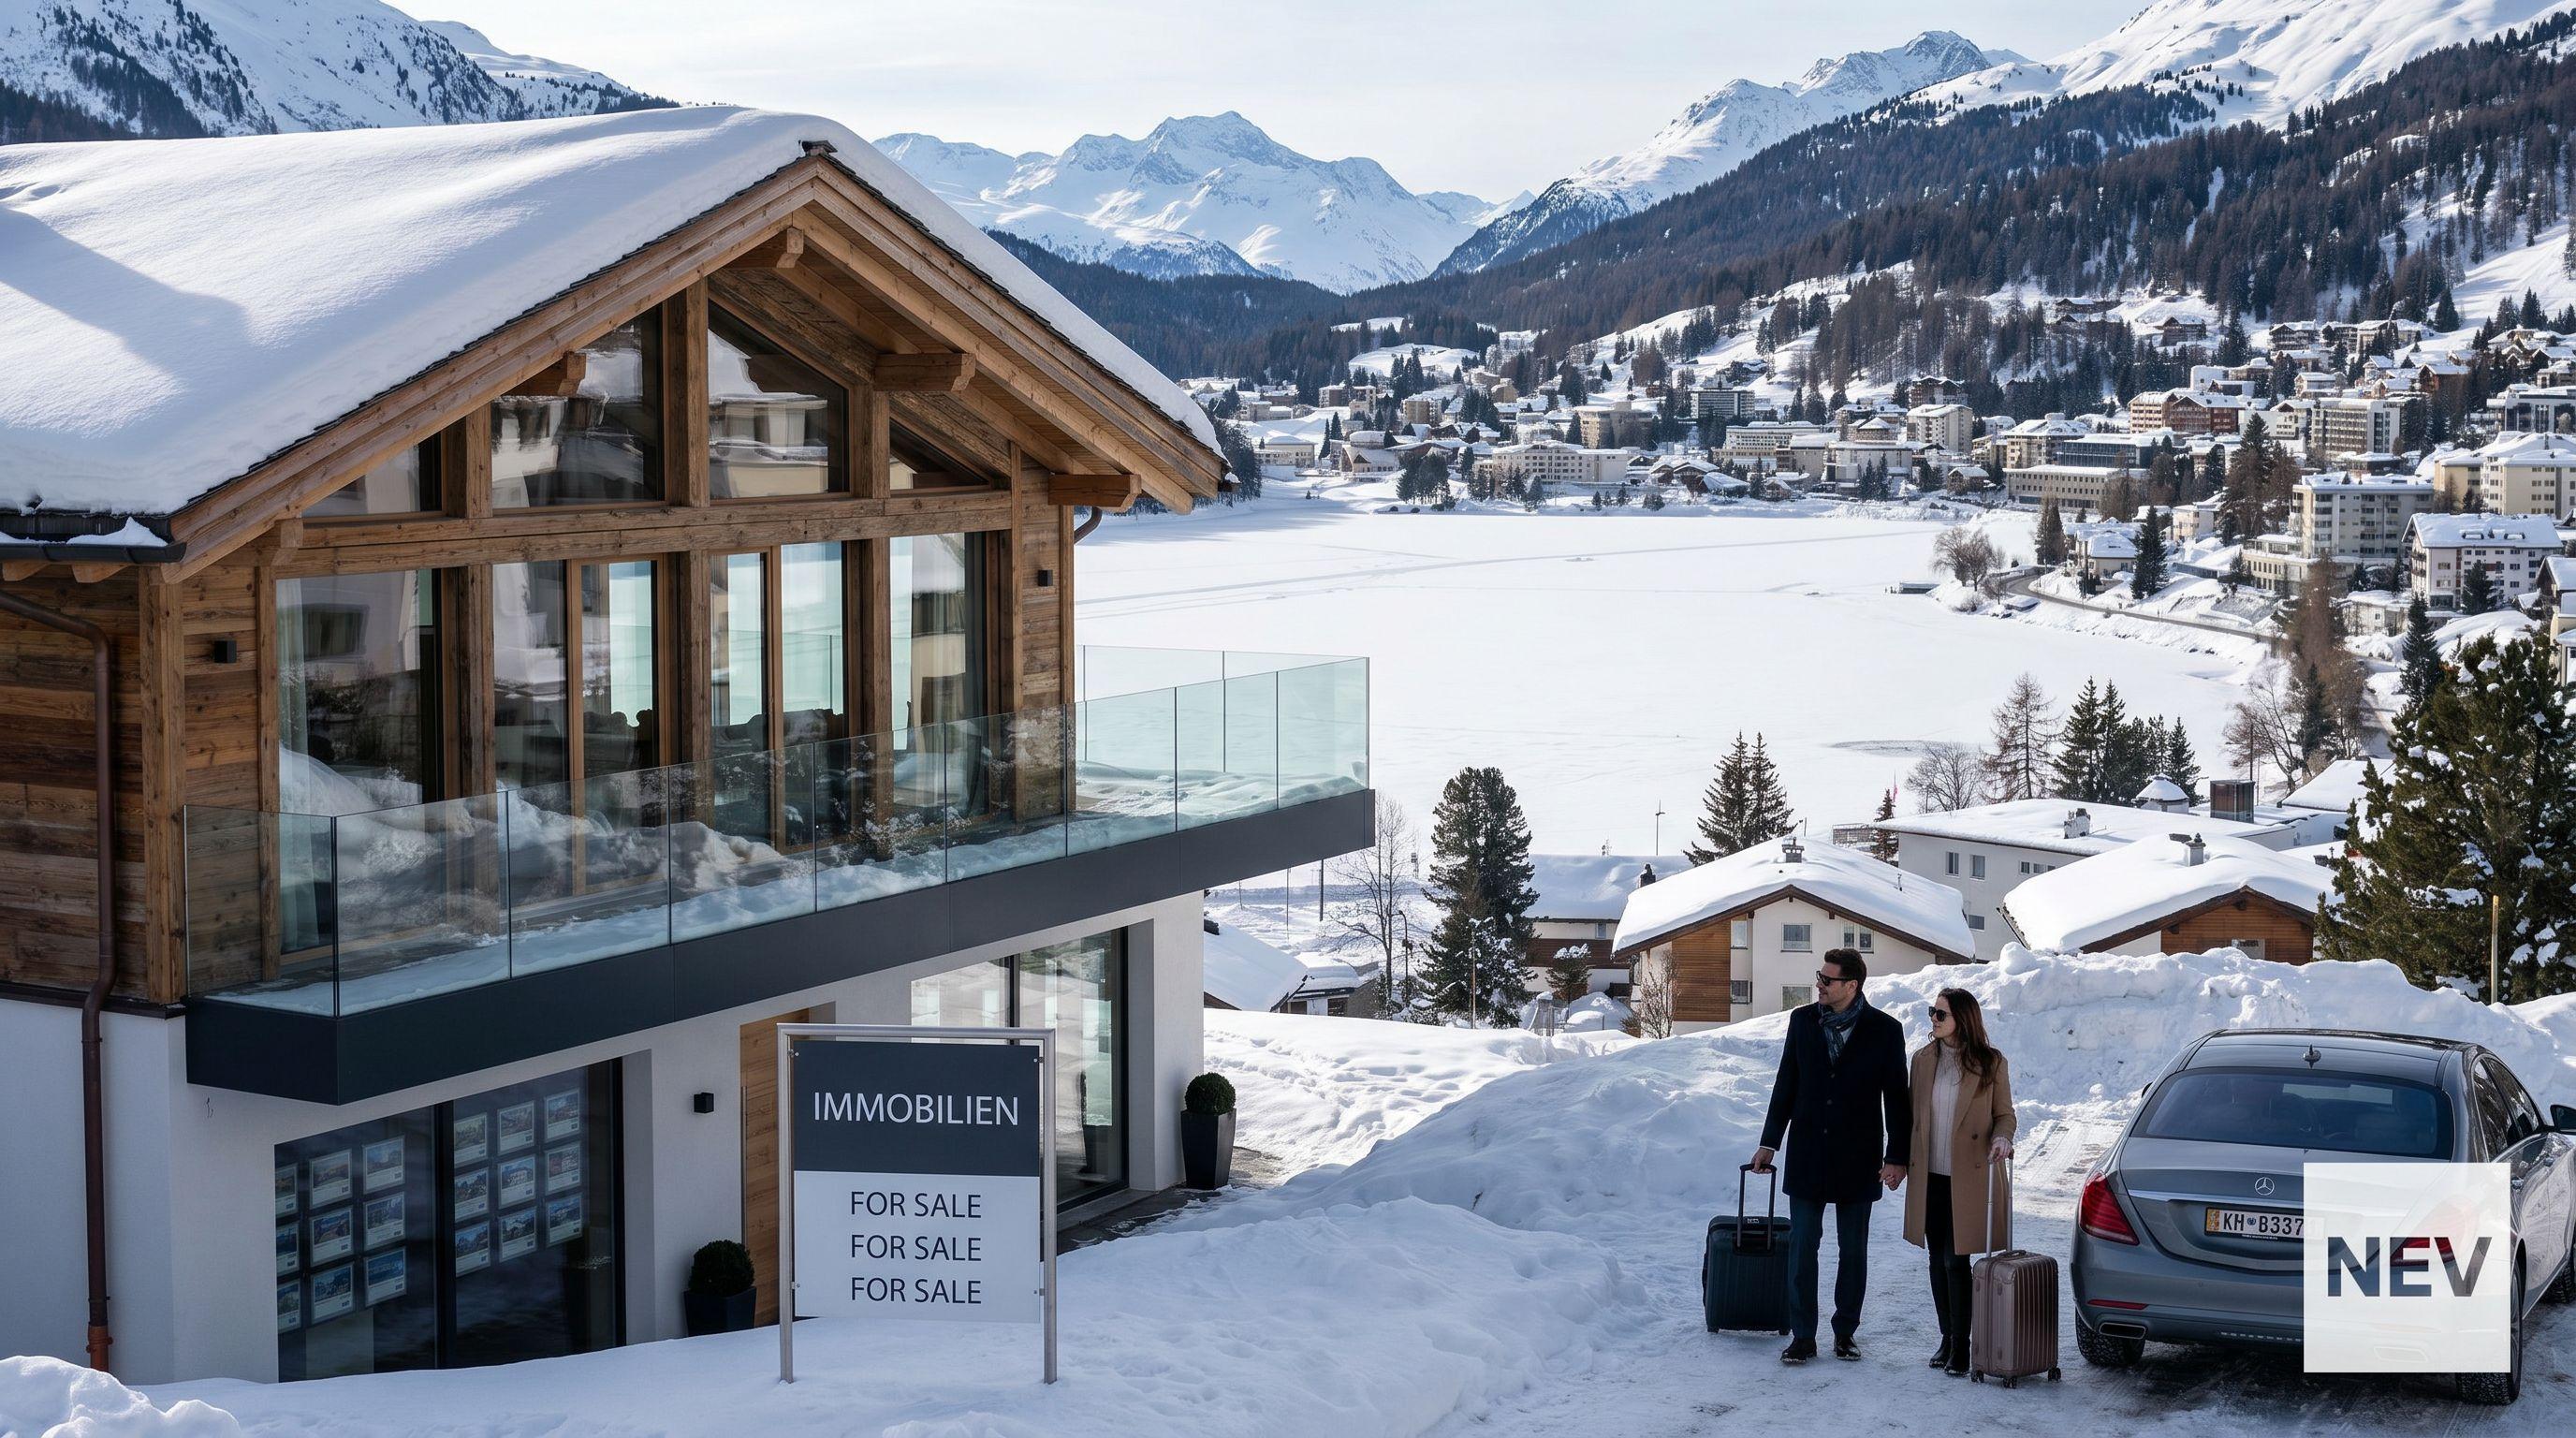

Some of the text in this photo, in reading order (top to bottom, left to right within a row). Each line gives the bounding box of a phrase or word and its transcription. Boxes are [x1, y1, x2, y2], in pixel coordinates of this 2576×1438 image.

[815, 1092, 1018, 1125] IMMOBILIEN
[851, 1191, 981, 1218] FOR SALE
[2258, 1215, 2310, 1236] B337
[851, 1234, 981, 1261] FOR SALE
[851, 1277, 981, 1304] FOR SALE
